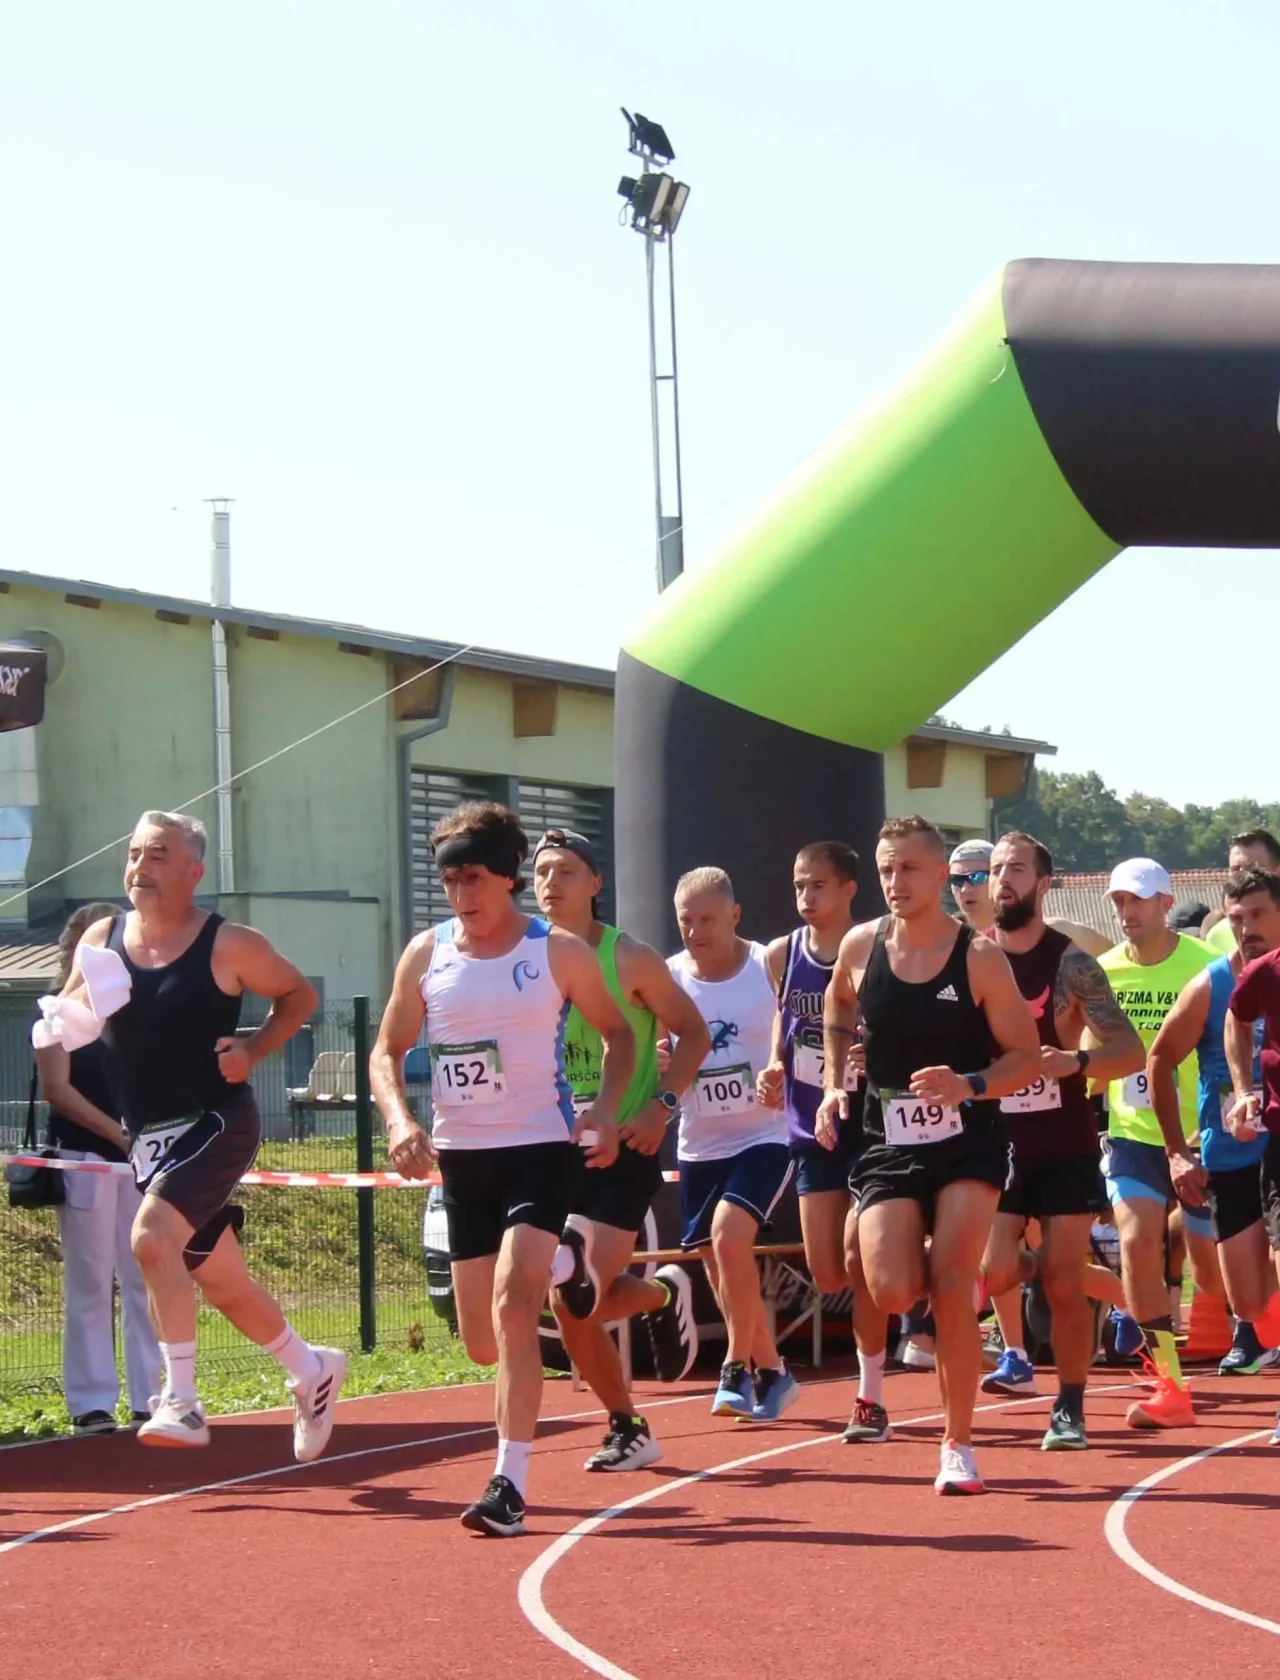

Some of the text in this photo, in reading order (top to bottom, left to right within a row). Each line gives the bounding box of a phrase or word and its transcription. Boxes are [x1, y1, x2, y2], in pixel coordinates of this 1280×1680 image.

[1115, 990, 1153, 1005] RIZMA
[442, 1060, 489, 1088] 152
[1137, 1074, 1148, 1094] 9
[702, 1079, 742, 1103] 100
[895, 1103, 944, 1128] 149
